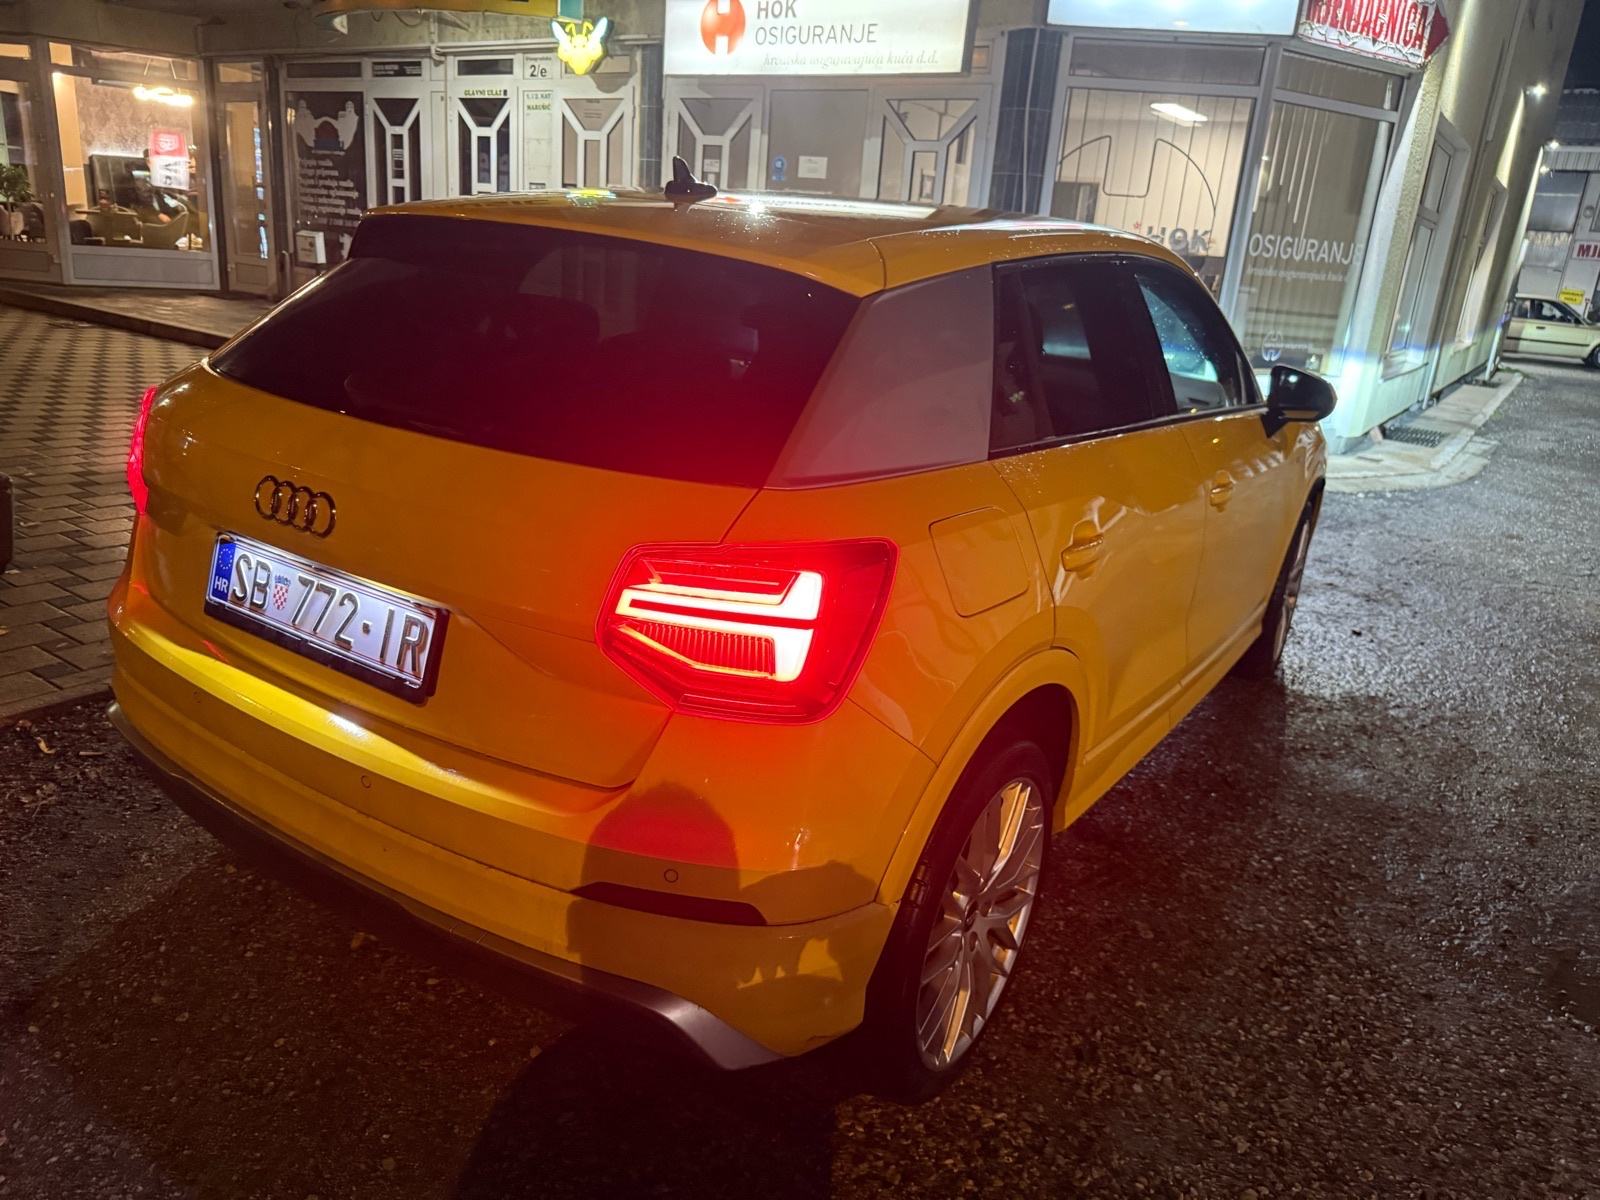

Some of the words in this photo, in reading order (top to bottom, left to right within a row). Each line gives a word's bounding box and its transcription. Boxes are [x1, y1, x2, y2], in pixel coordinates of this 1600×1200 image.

[757, 0, 797, 19] HOK
[755, 23, 878, 45] OSIGURANJE
[530, 64, 547, 77] 2/e
[1147, 226, 1211, 252] HOK
[214, 575, 229, 594] HR
[232, 553, 273, 611] SB
